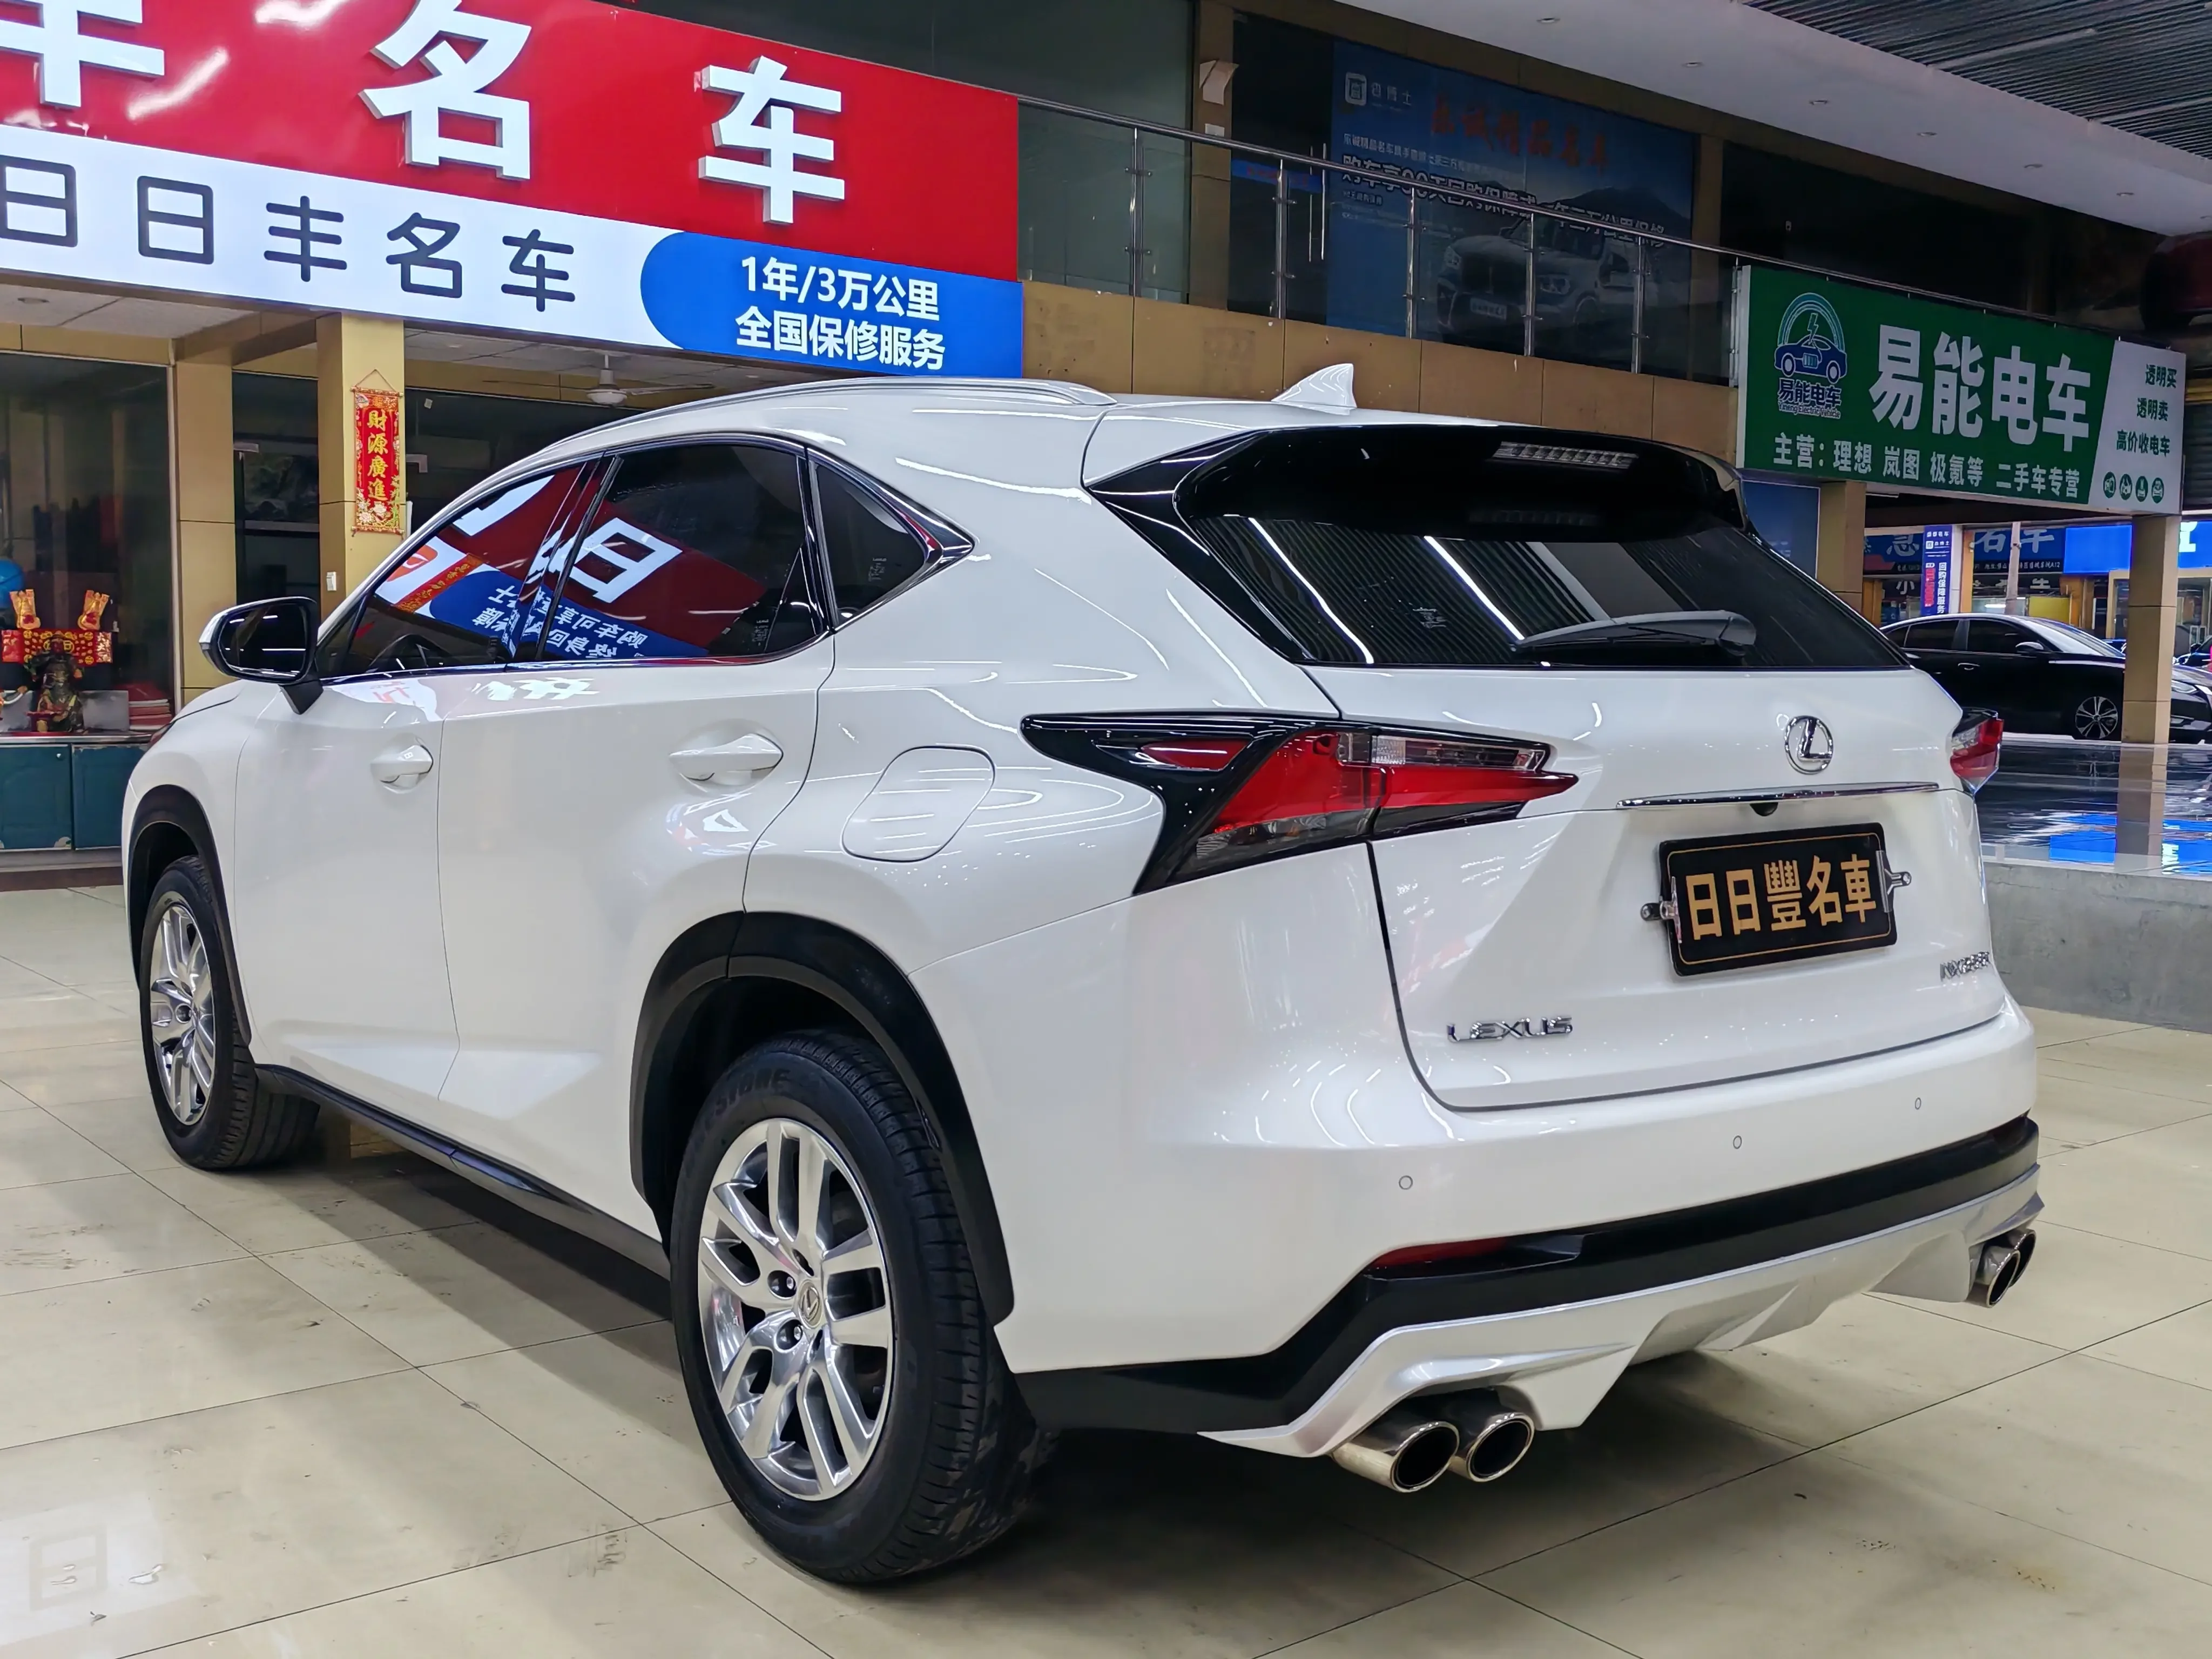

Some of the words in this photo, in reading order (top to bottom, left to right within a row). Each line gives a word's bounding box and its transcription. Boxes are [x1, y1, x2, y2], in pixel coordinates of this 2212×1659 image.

[0, 155, 576, 312] 日日丰名车
[741, 257, 940, 322] 1年/3万公里
[735, 306, 946, 371] 全国保修服务
[1777, 377, 1842, 409] 易能电车
[1869, 324, 2091, 452] 易能电车
[2144, 363, 2177, 389] 透明买
[2136, 396, 2169, 422] 透明卖
[367, 409, 389, 502] 財源廣進
[2116, 429, 2171, 457] 高价收电车
[1882, 447, 1920, 482] 岚图
[1930, 453, 1984, 486] 极氪等
[1995, 463, 2080, 499] 二手车专营
[1684, 853, 1877, 941] 日日豐名車
[1447, 1015, 1573, 1043] LEXUS
